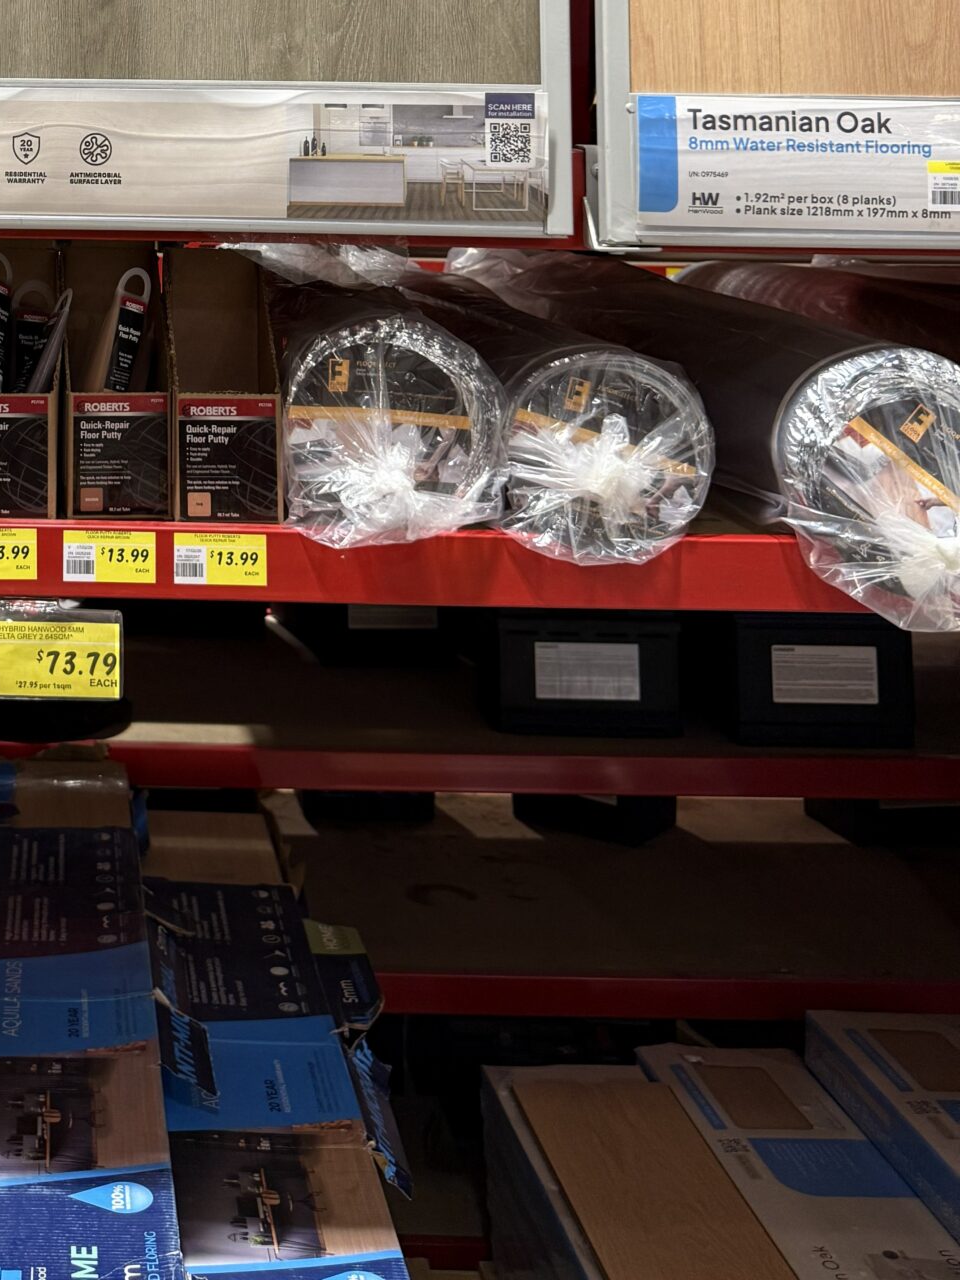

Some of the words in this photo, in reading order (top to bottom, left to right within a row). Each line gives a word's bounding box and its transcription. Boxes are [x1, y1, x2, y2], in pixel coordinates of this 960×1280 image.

[687, 109, 830, 133] Tasmanian
[836, 111, 892, 134] Oak
[688, 137, 729, 151] 8mm
[733, 137, 781, 152] Water
[786, 138, 862, 153] Resistant
[866, 140, 932, 158] Flooring
[692, 192, 719, 205] HW
[787, 196, 807, 206] per
[811, 194, 834, 204] box
[836, 194, 849, 206] (8
[852, 194, 897, 207] planks)
[744, 205, 776, 215] Plank
[780, 206, 803, 216] size
[806, 206, 854, 217] 1218mm
[866, 207, 908, 218] 197mm
[922, 208, 951, 219] 8mm
[84, 402, 130, 412] ROBERTS
[190, 406, 237, 416] ROBERTS
[101, 548, 149, 563] $13.99
[210, 551, 258, 566] $13.99
[37, 649, 116, 675] $73.79
[90, 679, 117, 687] EACH
[6, 960, 23, 994] SANDS
[2, 995, 23, 1038] AQUILA
[264, 1078, 279, 1100] YEAR
[268, 1101, 281, 1113] 20
[112, 1184, 124, 1210] 100%
